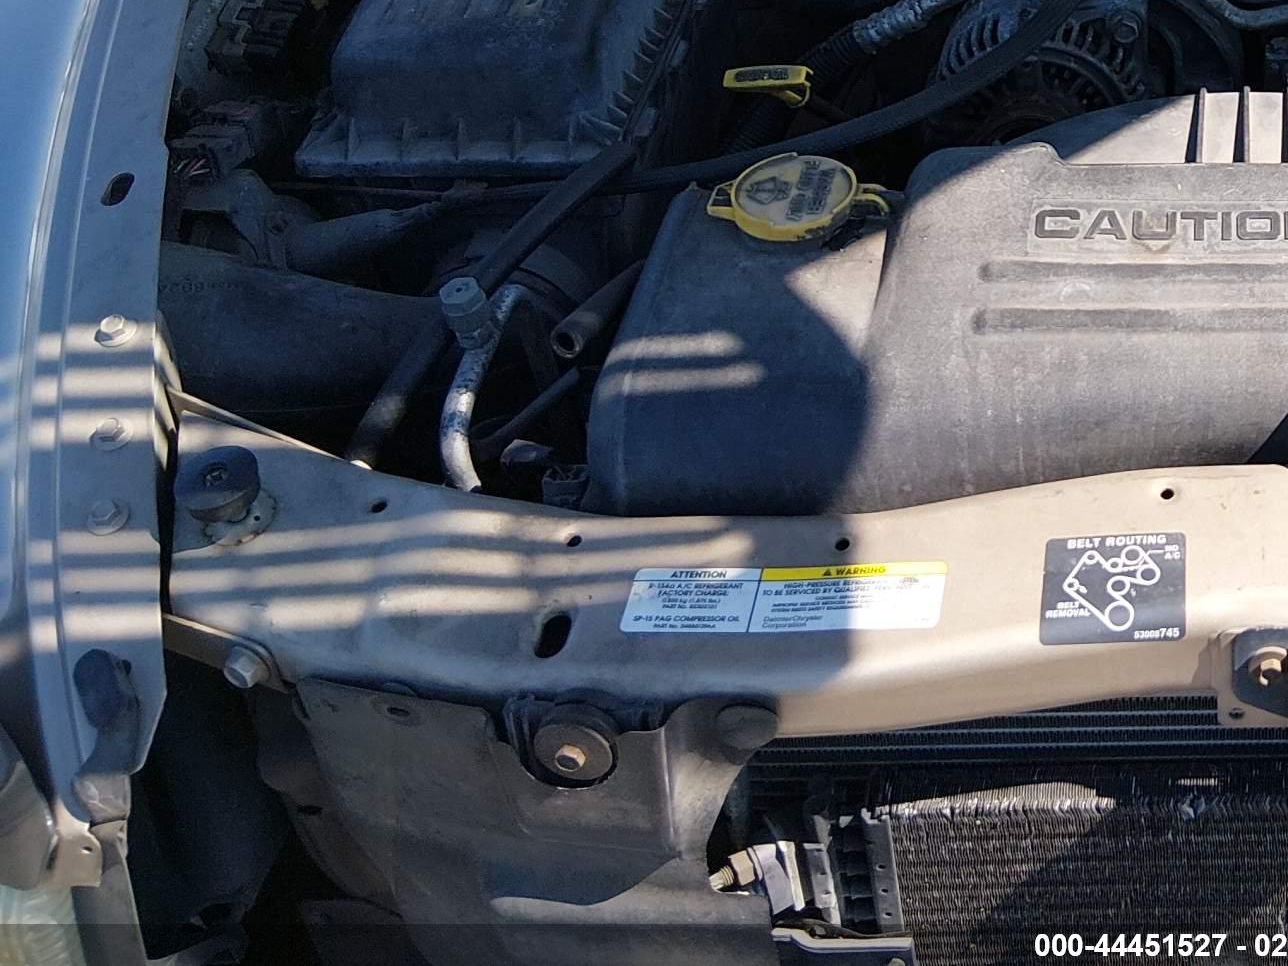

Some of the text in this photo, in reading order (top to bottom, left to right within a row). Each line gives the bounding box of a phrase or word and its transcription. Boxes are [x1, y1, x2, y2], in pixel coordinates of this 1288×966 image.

[1066, 534, 1168, 550] BELT ROUTING
[1164, 552, 1181, 560] A/C
[670, 570, 728, 579] ATTENTION
[835, 566, 887, 577] WARNING
[774, 588, 783, 596] BE
[784, 587, 822, 596] SERVICED
[1056, 601, 1081, 610] BELT
[1045, 608, 1092, 619] REMOVAL
[762, 621, 808, 630] Corporation
